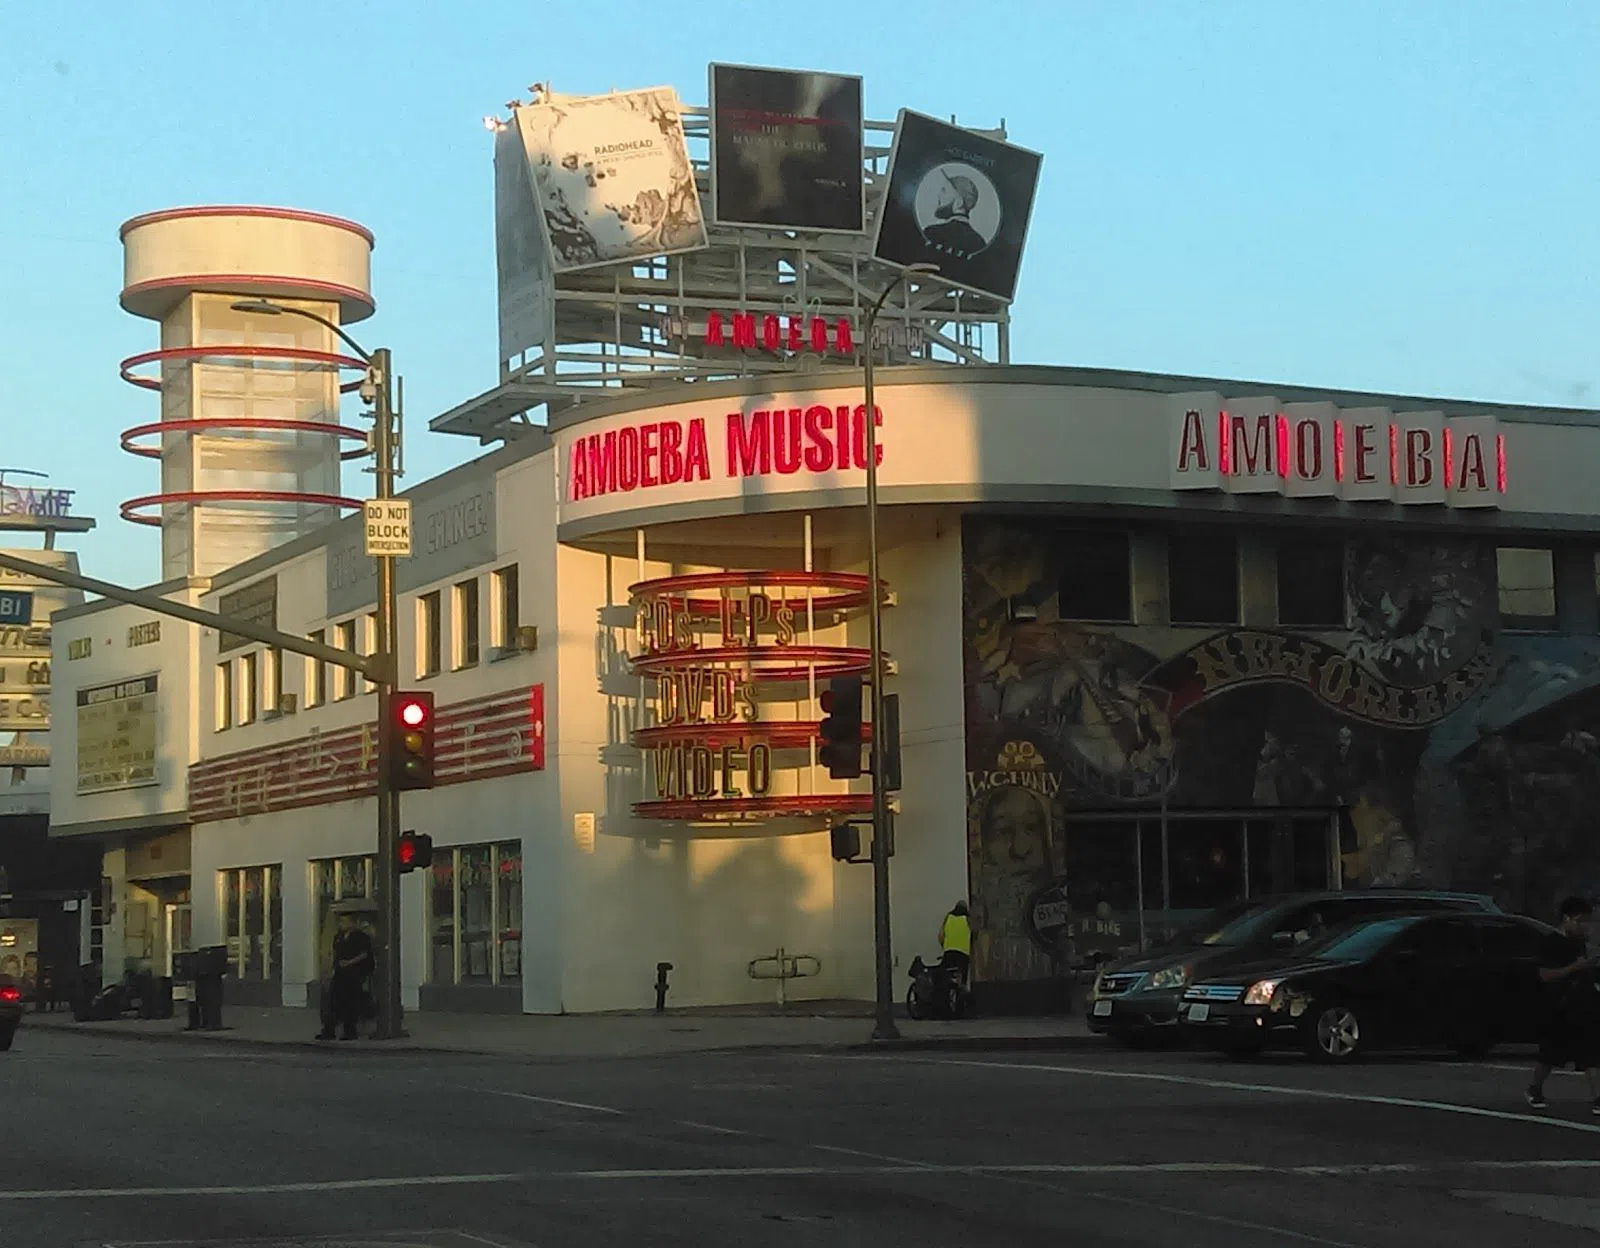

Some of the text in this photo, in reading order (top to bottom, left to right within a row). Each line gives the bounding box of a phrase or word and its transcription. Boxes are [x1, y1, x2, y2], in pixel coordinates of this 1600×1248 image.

[594, 139, 653, 155] RADIOHEAD
[705, 311, 852, 353] AMOEBA
[571, 403, 884, 501] AMOEBA MUSIC
[1176, 408, 1490, 493] AMOEBA
[368, 507, 408, 519] DO NOT
[368, 525, 409, 538] BLOCK
[369, 541, 408, 550] INTERSECTION
[1186, 630, 1322, 692] NEW
[656, 667, 759, 725] DVDs
[653, 743, 771, 798] VIDEO
